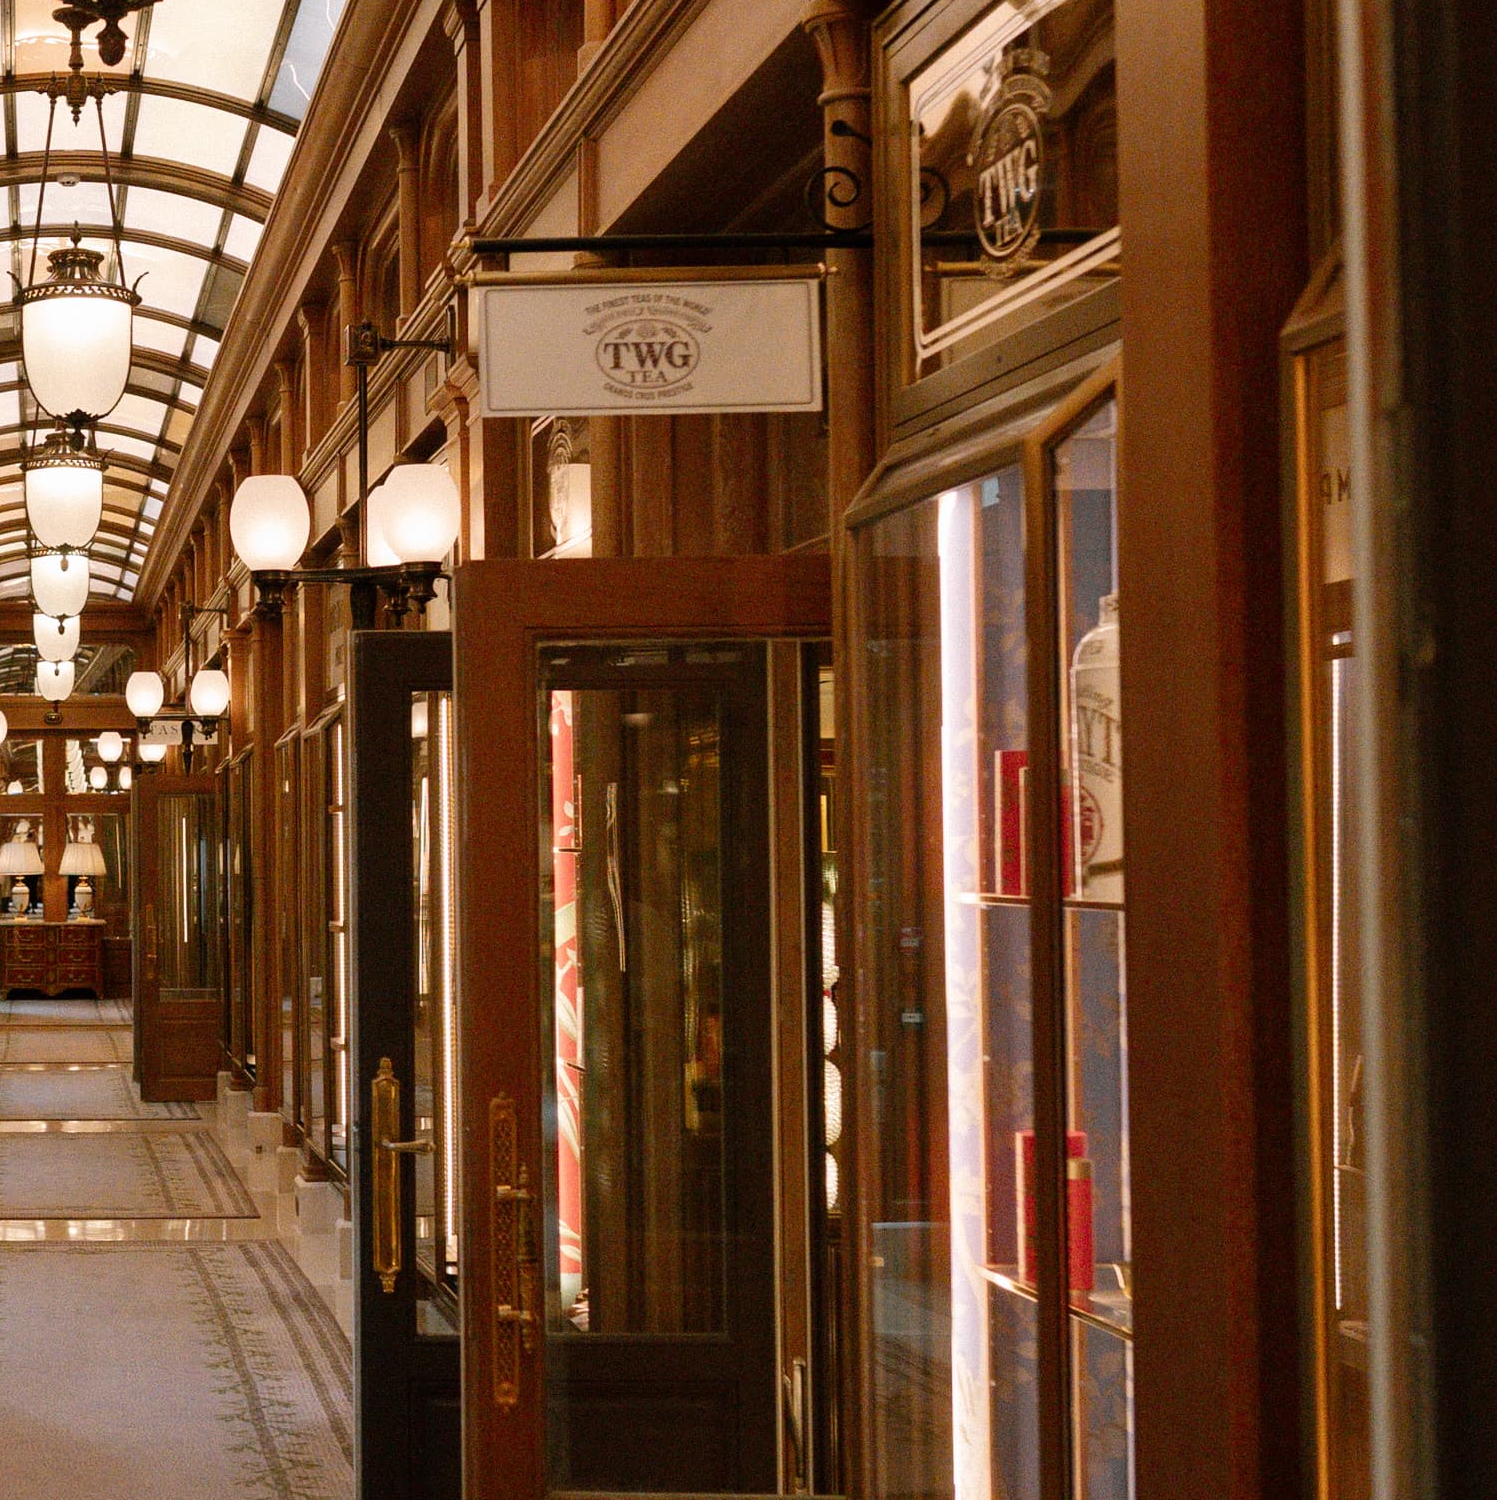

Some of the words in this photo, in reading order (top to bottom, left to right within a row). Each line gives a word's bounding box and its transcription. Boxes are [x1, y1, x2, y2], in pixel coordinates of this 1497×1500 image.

[978, 138, 1039, 228] TWG
[603, 340, 692, 370] TWG
[626, 370, 668, 384] TEA
